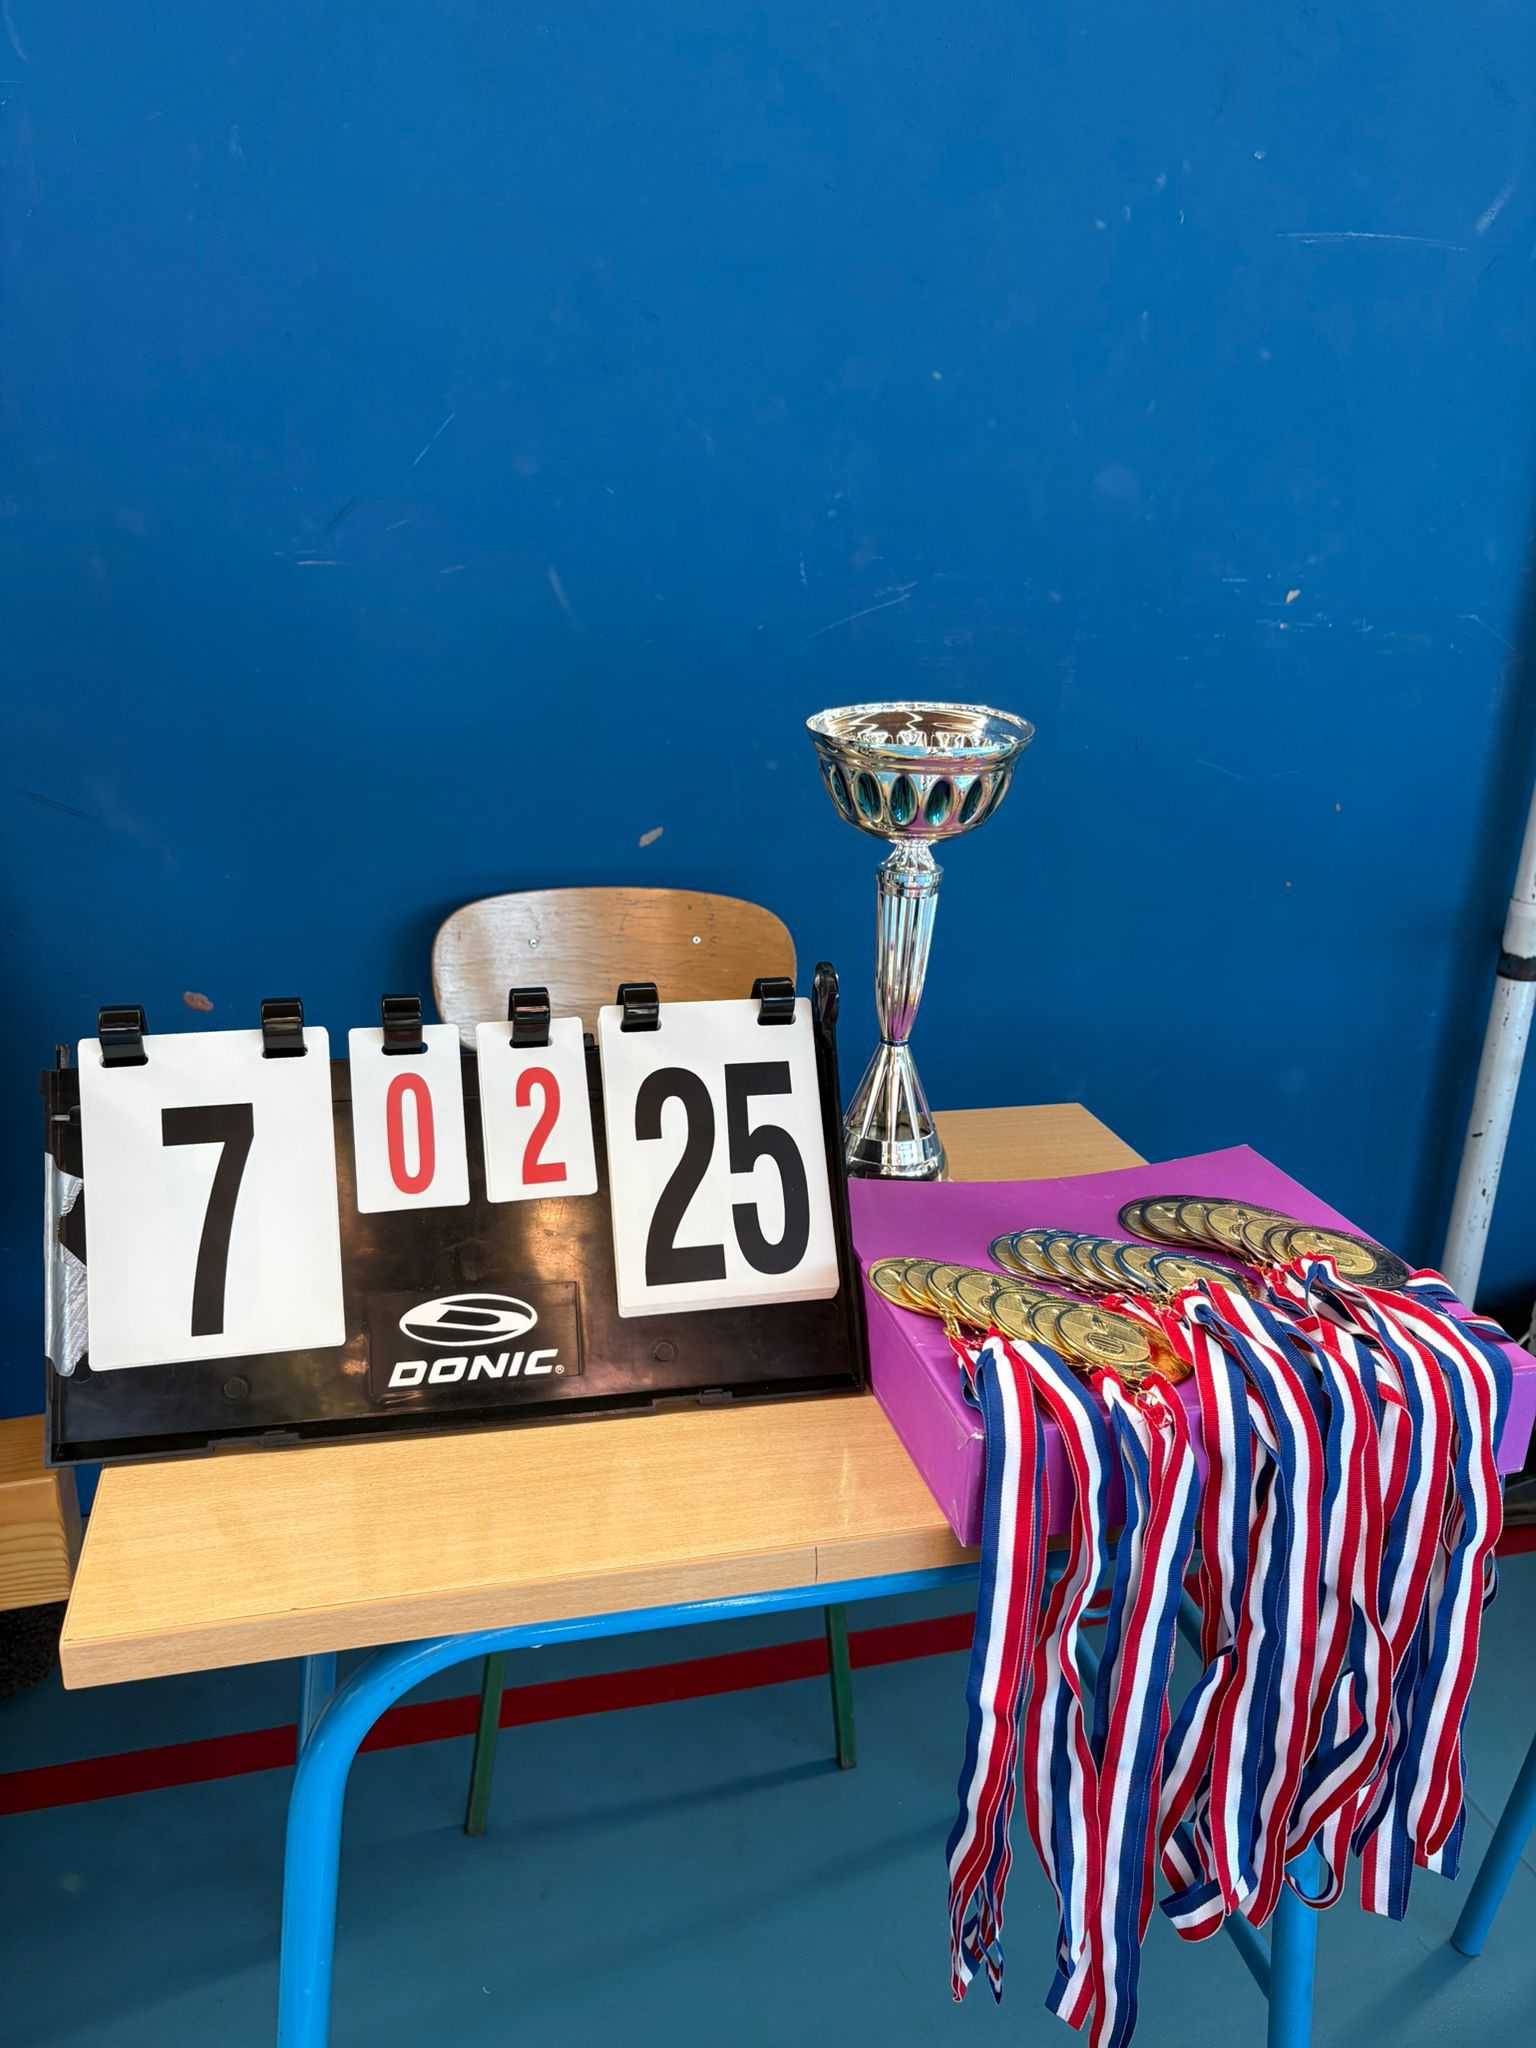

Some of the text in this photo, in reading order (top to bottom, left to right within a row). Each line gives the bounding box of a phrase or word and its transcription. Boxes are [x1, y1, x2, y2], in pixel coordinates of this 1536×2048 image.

[386, 1072, 435, 1195] 0
[515, 1066, 567, 1186] 2
[635, 1061, 809, 1287] 25
[162, 1103, 254, 1337] 7
